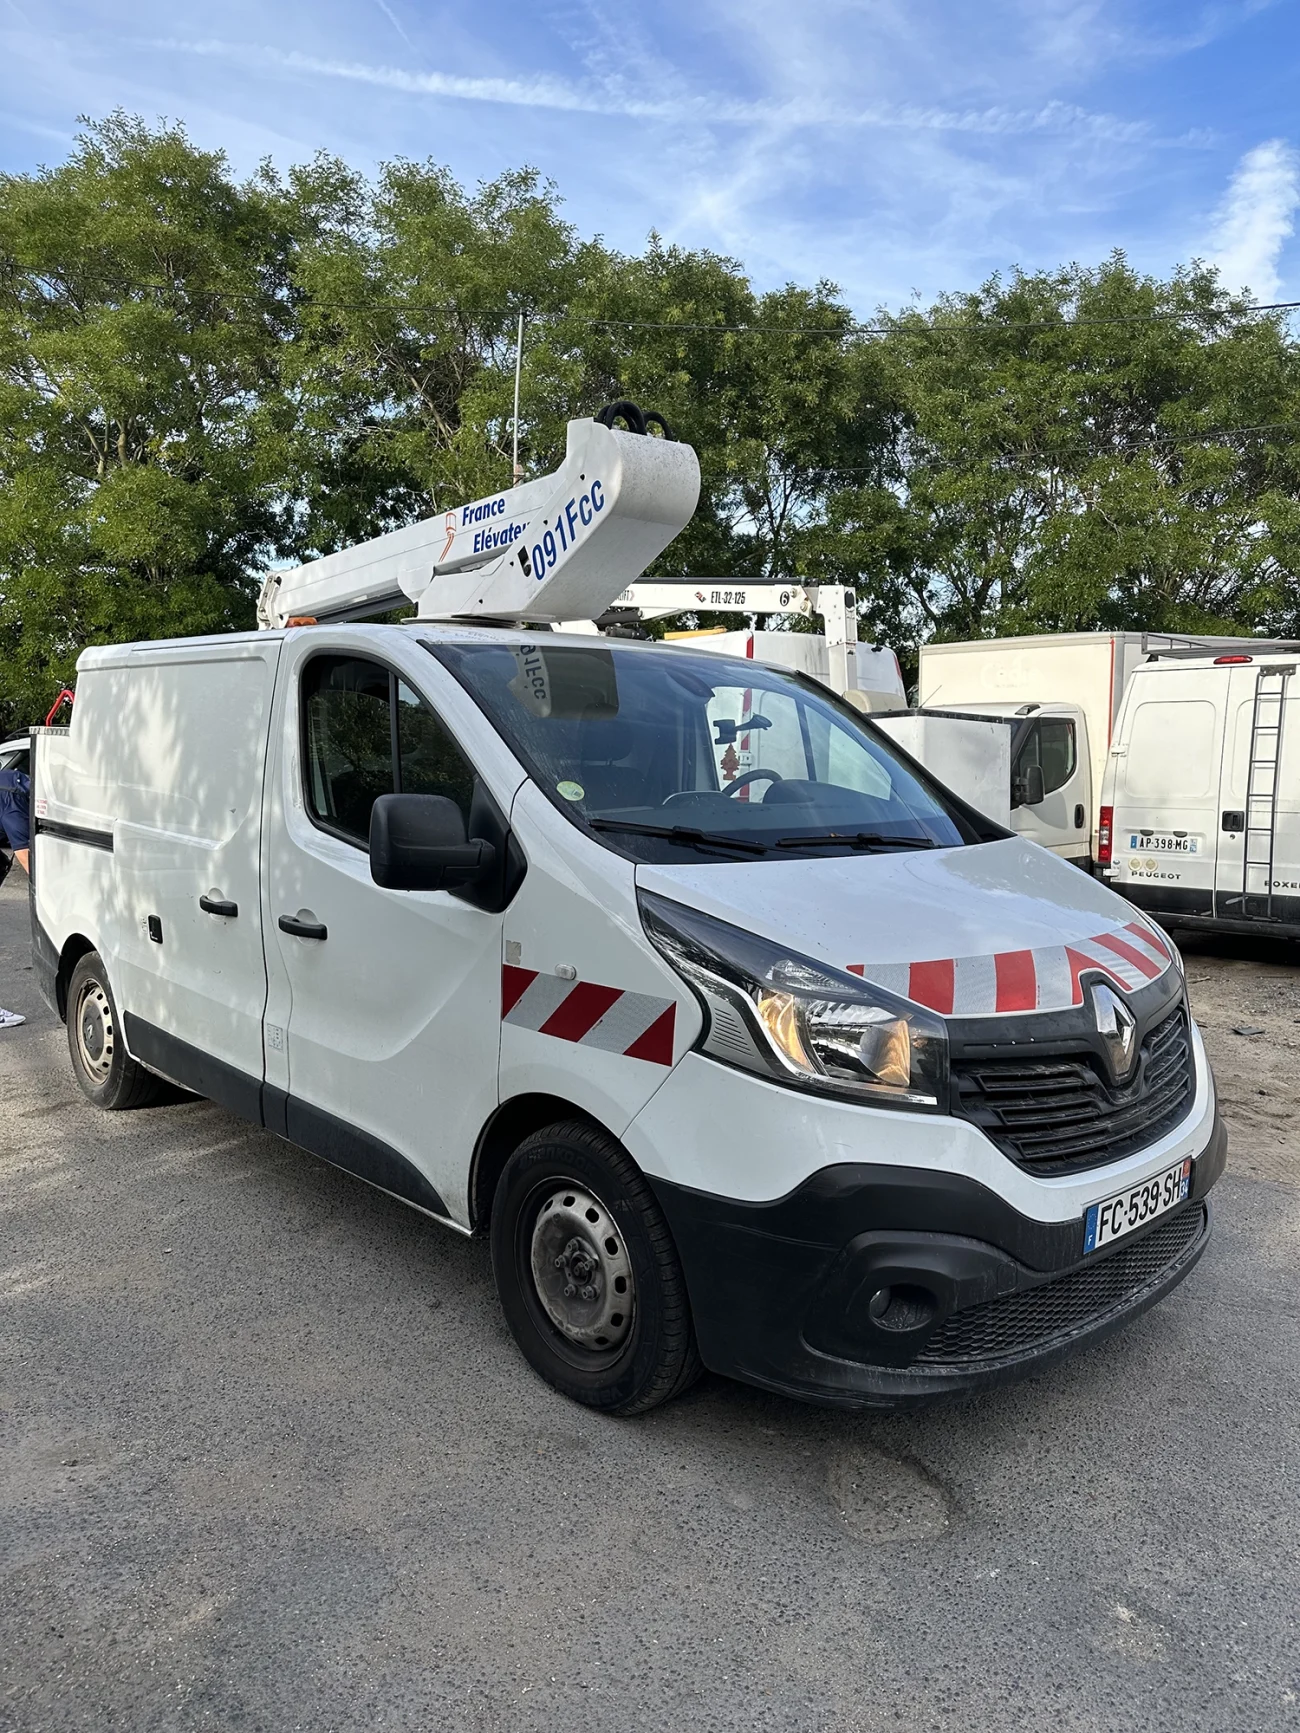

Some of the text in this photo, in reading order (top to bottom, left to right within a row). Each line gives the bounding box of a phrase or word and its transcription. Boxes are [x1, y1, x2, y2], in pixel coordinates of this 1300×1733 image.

[462, 498, 505, 526] France
[532, 480, 605, 581] 091FCC
[710, 591, 746, 604] ETL-32-125
[1140, 837, 1188, 850] AP-398-MG
[1131, 870, 1181, 880] PEUGEOT
[1264, 880, 1300, 889] BOXE
[1098, 1166, 1183, 1242] FC-539-SH
